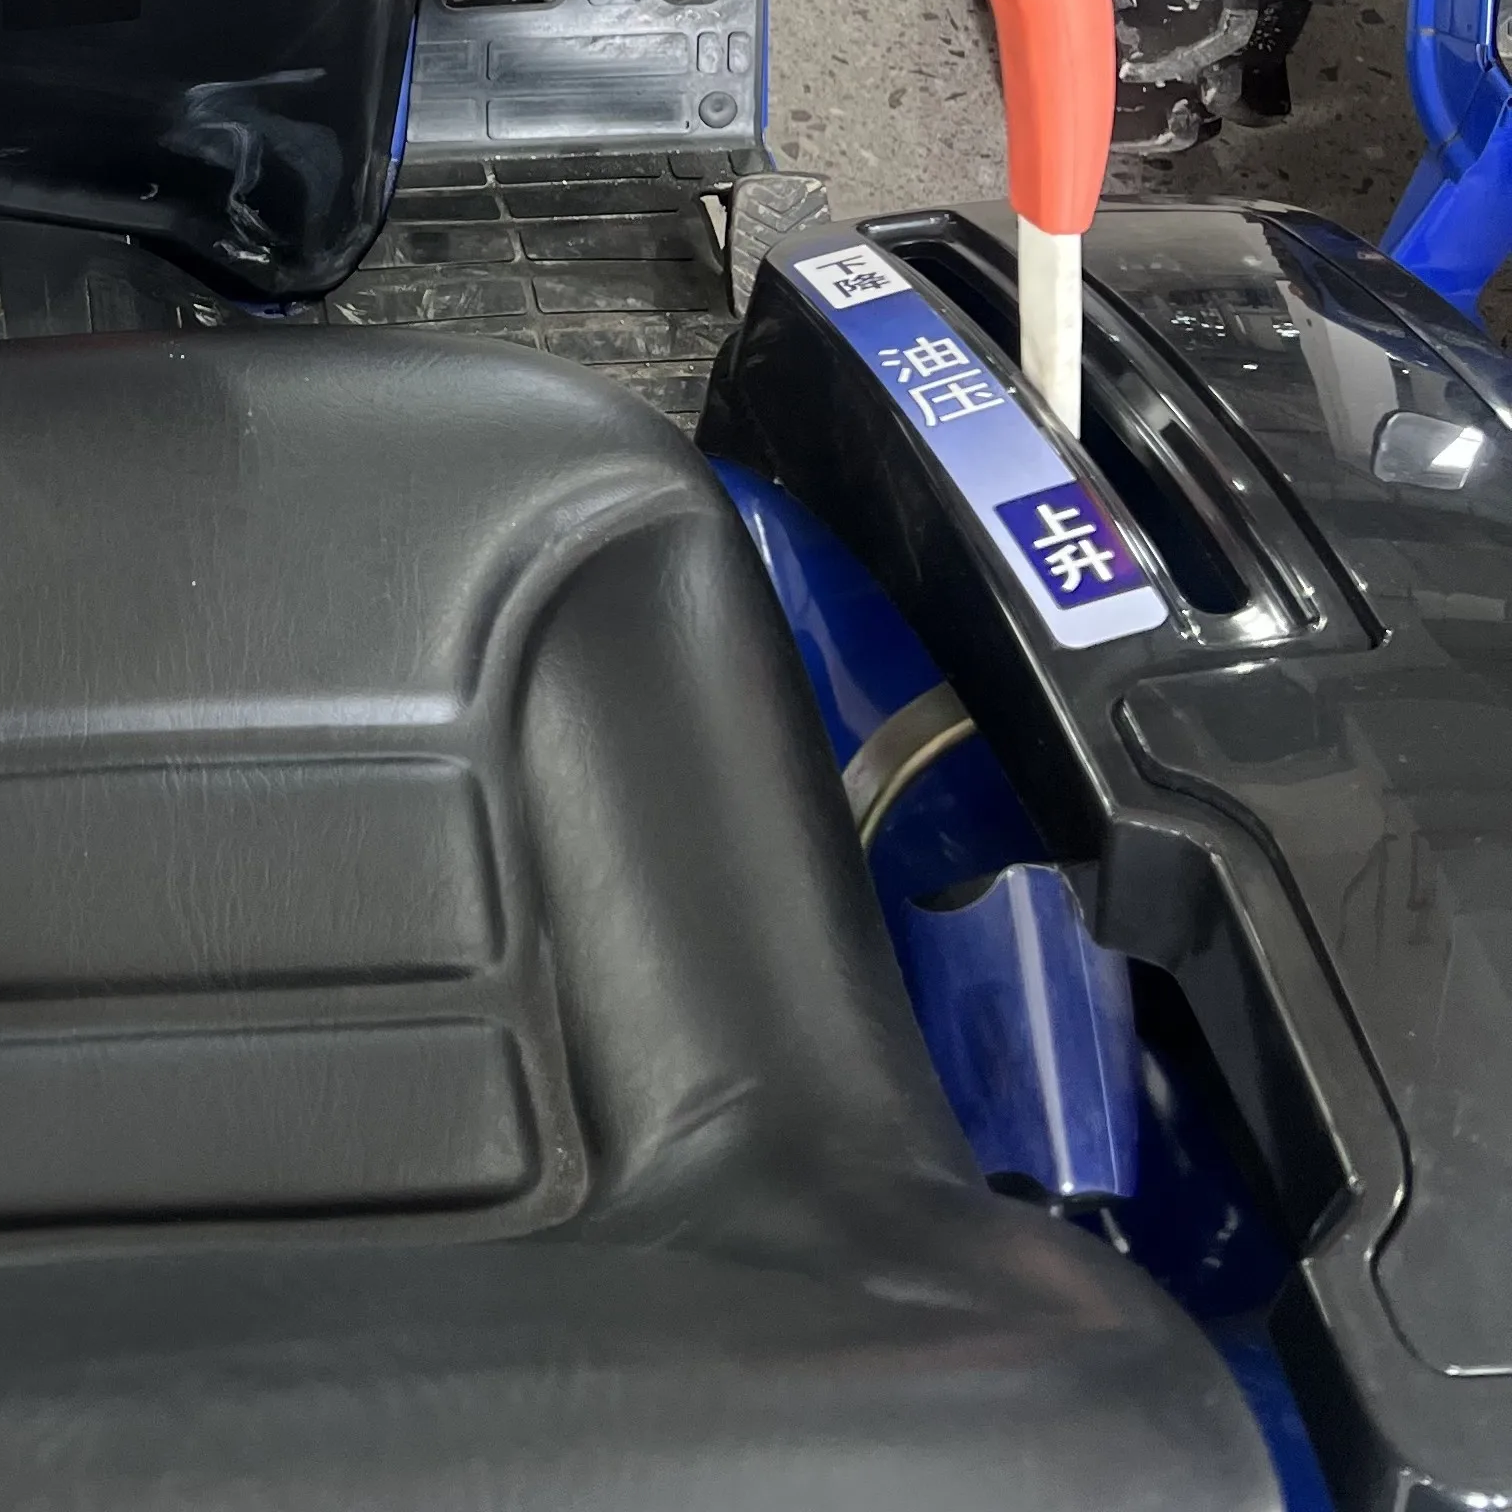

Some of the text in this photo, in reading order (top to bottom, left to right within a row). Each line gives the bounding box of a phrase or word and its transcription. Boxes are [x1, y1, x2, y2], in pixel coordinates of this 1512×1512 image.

[815, 254, 892, 299] 下降
[877, 336, 1006, 428] 油压
[1033, 503, 1116, 593] 上升
